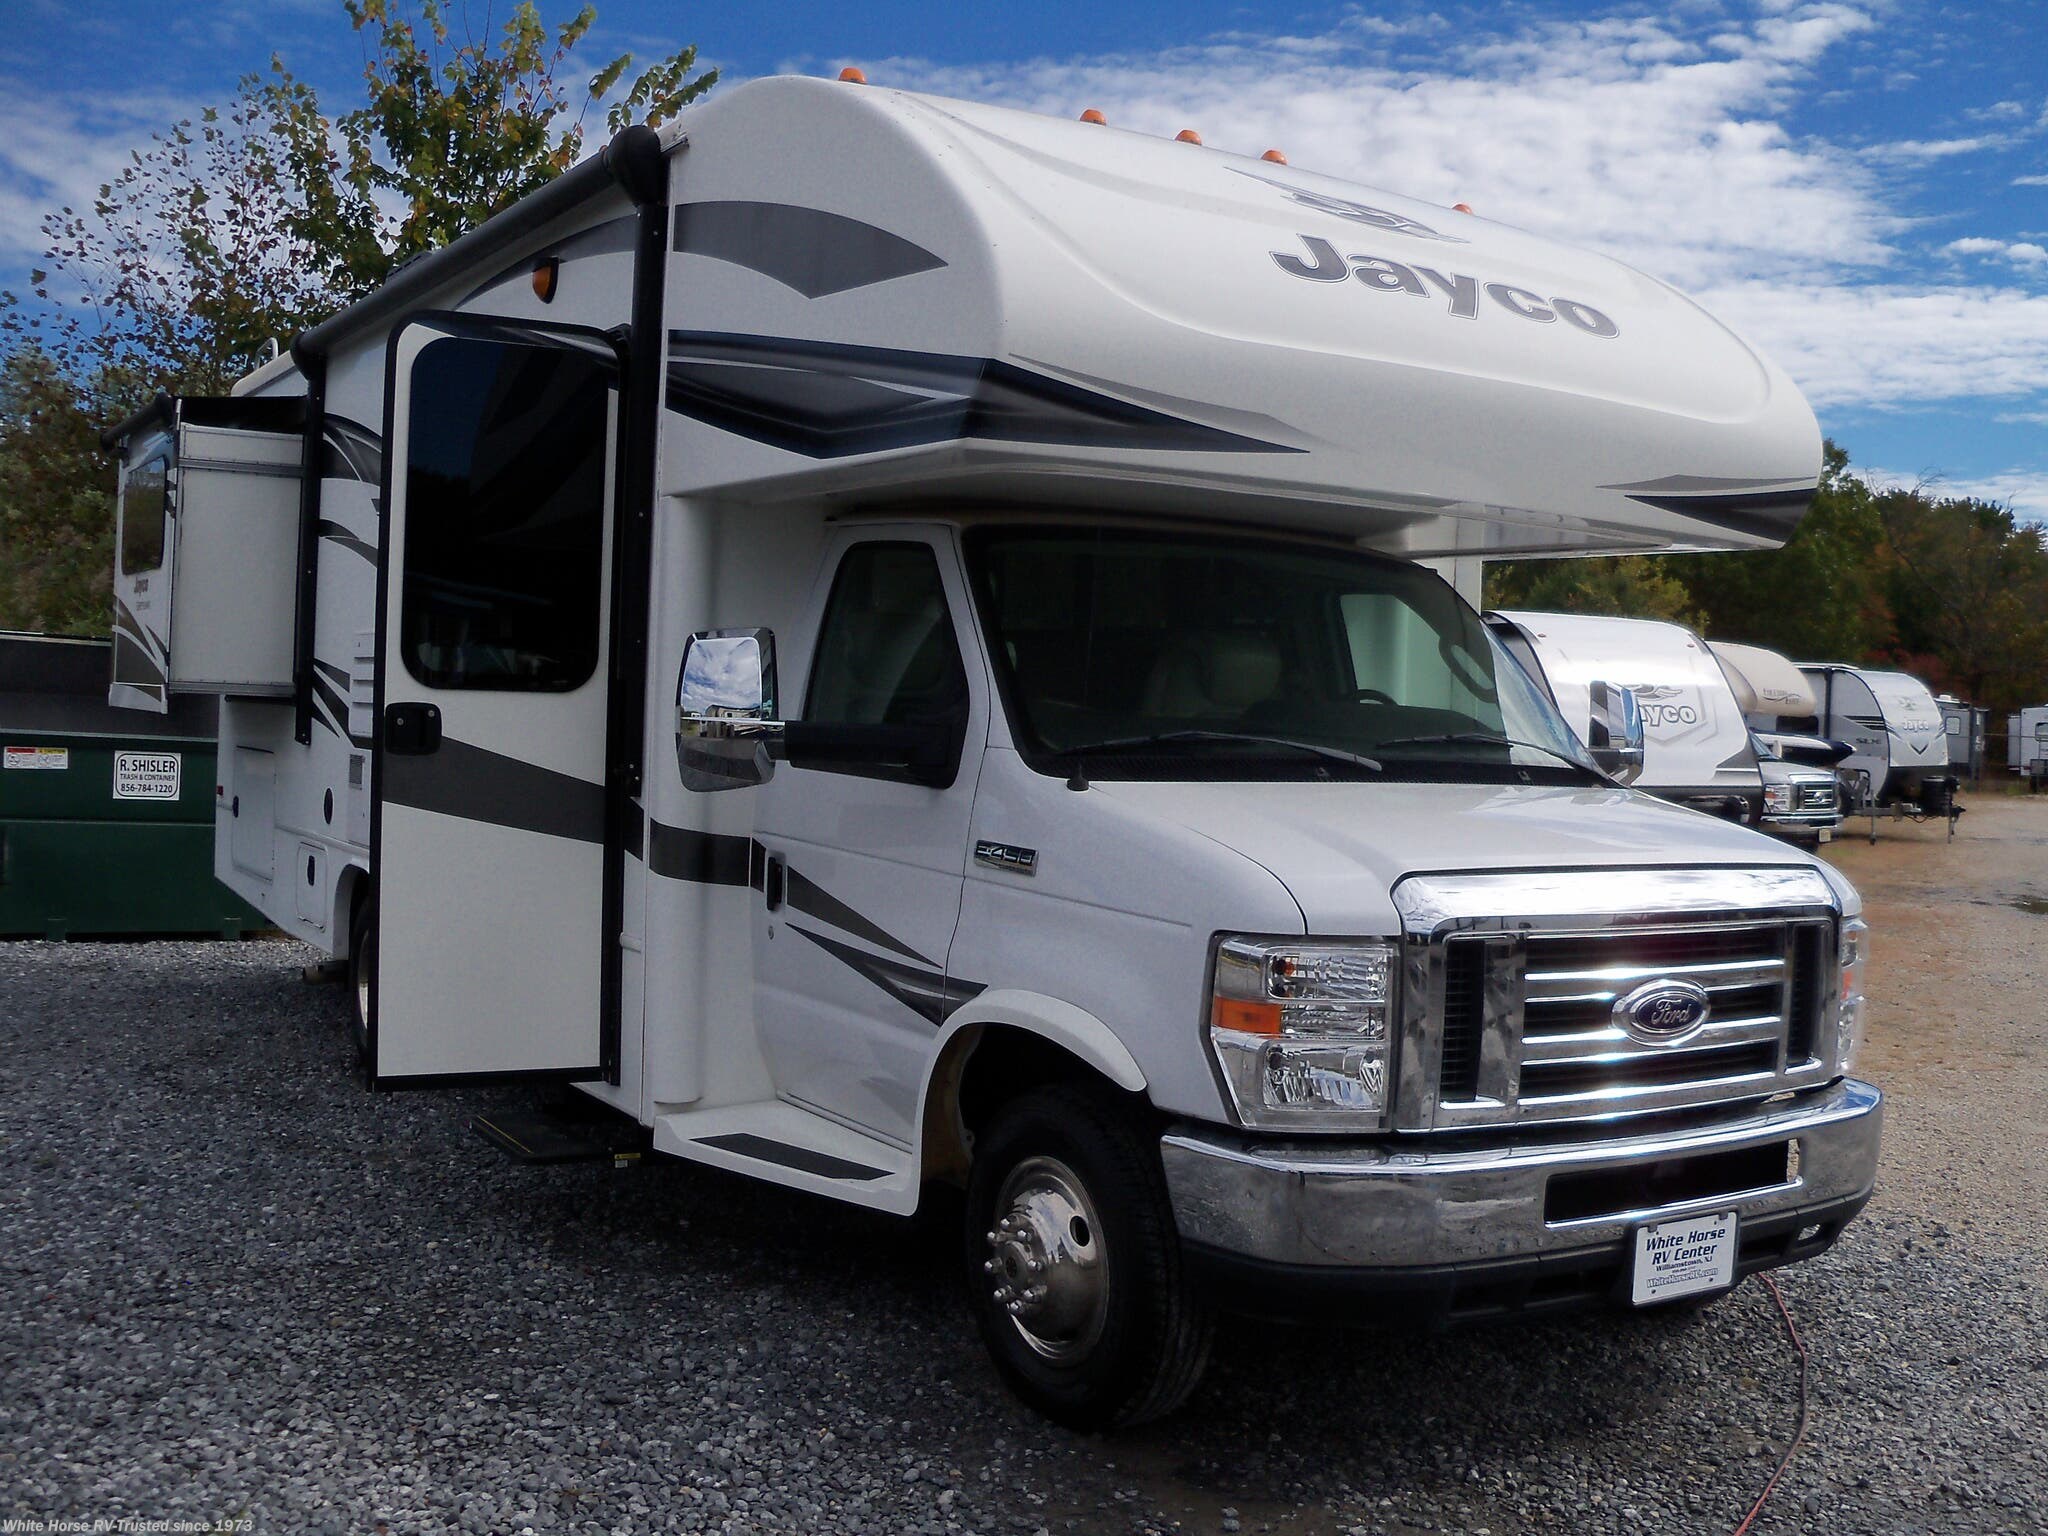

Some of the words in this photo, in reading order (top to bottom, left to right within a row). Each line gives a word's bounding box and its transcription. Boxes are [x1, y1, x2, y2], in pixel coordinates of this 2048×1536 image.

[1268, 232, 1620, 339] Jayco
[120, 759, 130, 771] R.
[132, 759, 176, 773] SHISLER
[120, 773, 138, 781] TRASH
[121, 783, 173, 793] 856-784-1220
[1651, 998, 1692, 1025] Ford
[1646, 1235, 1684, 1251] White
[1687, 1228, 1726, 1244] Horse
[1652, 1250, 1672, 1265] RV
[1674, 1245, 1718, 1261] Center
